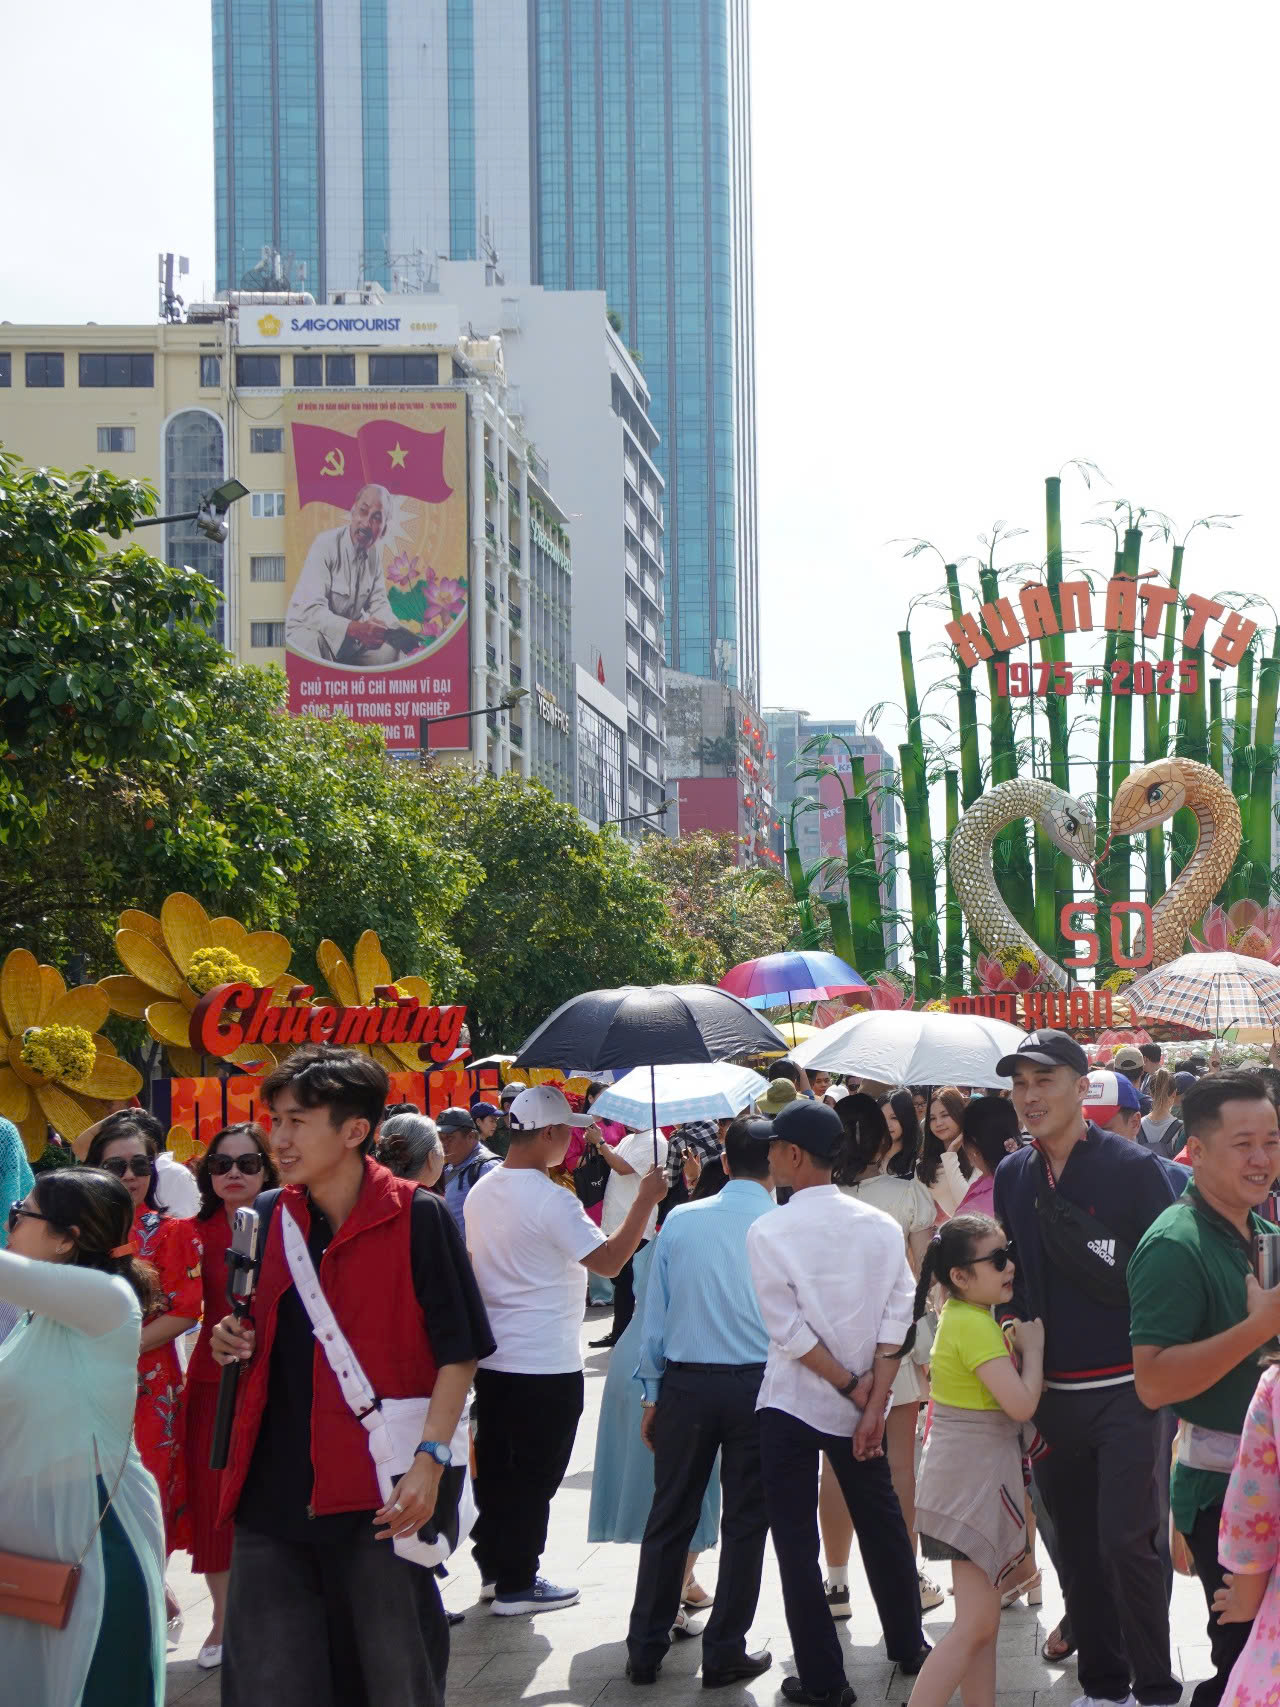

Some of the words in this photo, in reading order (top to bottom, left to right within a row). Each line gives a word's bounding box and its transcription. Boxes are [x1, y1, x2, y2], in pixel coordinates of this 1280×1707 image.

[291, 318, 401, 331] SAIGONTOURIST
[944, 581, 1094, 668] XUÂN
[300, 676, 322, 696] CHỦ
[324, 680, 348, 698] TỊCH
[351, 676, 365, 695] HỒ
[368, 678, 386, 695] CHÍ
[389, 679, 417, 695] MINH
[420, 677, 430, 693] VĨ
[433, 678, 451, 696] ĐẠI
[994, 662, 1073, 698] 1975
[1110, 660, 1199, 696] 2025
[356, 702, 392, 717] TRONG
[395, 701, 410, 720] SỰ
[403, 725, 415, 740] TA
[823, 806, 843, 820] KFC
[1087, 1240, 1116, 1267] adidas
